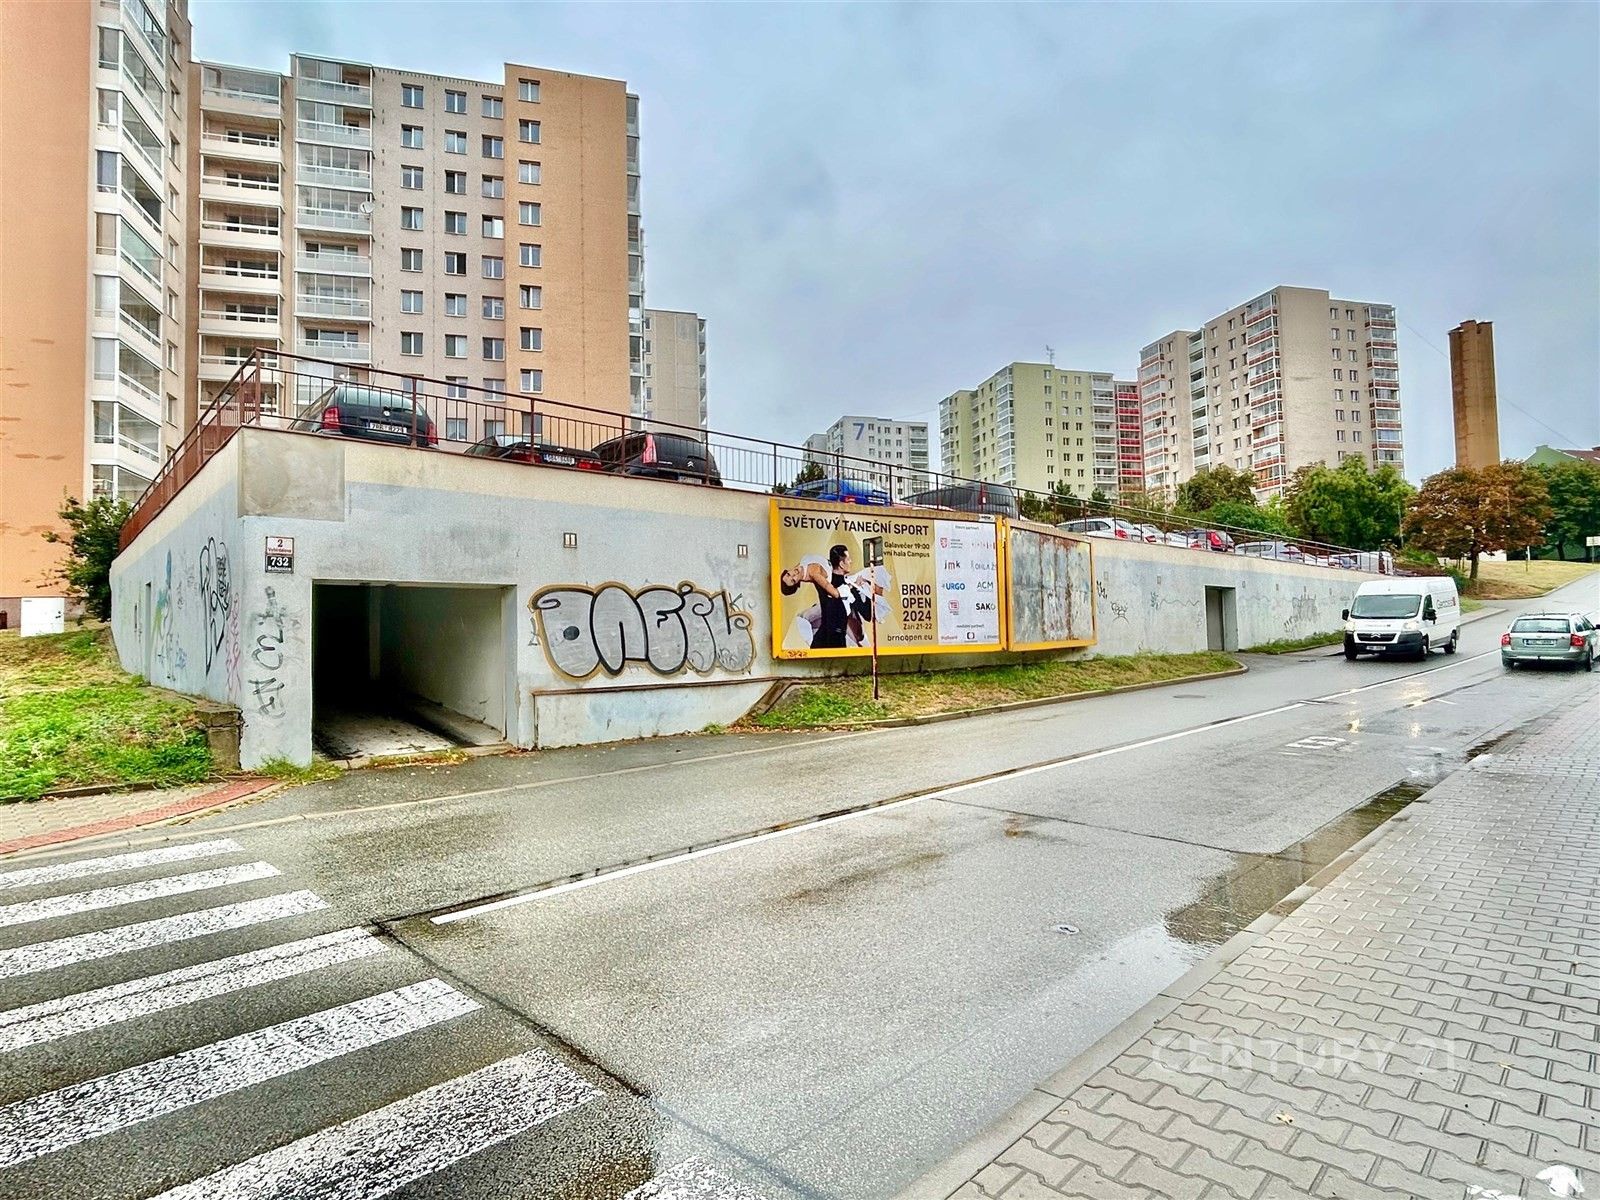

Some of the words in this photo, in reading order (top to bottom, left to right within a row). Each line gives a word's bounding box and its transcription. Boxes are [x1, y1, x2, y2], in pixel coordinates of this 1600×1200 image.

[853, 423, 865, 440] 7
[783, 514, 840, 531] SVĚTOVÝ
[842, 519, 892, 533] TANEČNÍ
[893, 524, 929, 536] SPORT
[277, 539, 283, 547] 2
[884, 541, 913, 549] Galavečer
[907, 551, 930, 559] Campus
[270, 557, 290, 566] 732
[945, 582, 966, 591] URGO
[976, 581, 994, 589] ACM
[901, 584, 931, 596] BRNO
[902, 597, 932, 609] OPEN
[975, 603, 996, 611] SAKO
[902, 610, 932, 622] 2024
[887, 634, 933, 642] brnoopen.eu
